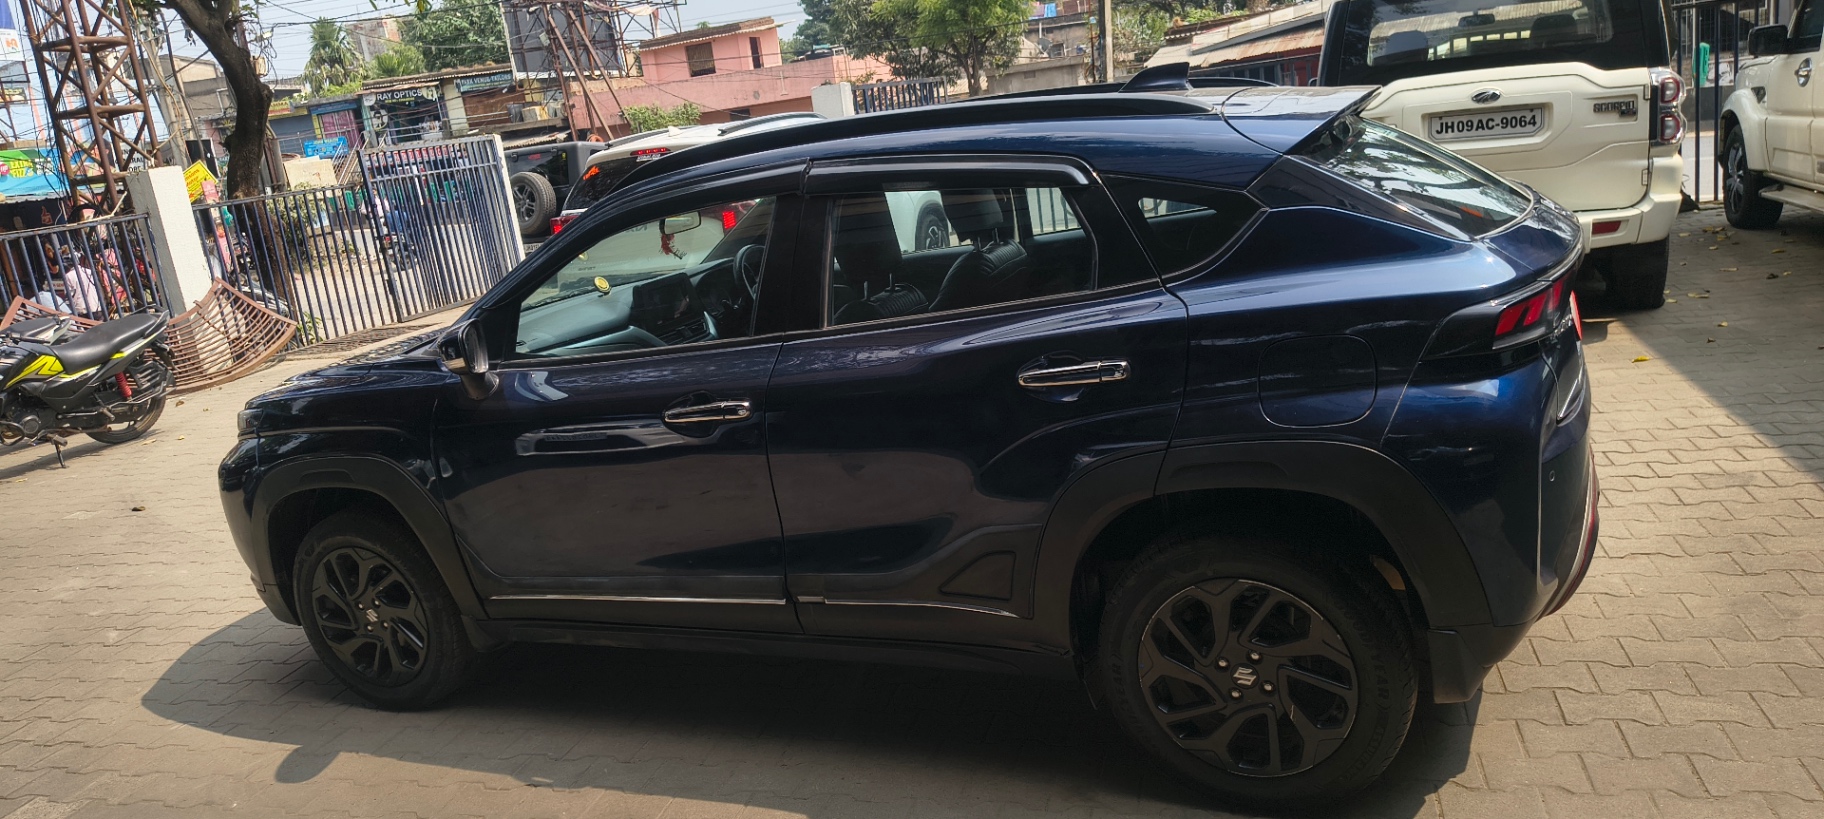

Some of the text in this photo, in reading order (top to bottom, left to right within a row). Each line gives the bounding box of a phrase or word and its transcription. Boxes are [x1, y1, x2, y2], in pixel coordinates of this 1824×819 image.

[377, 92, 392, 101] RAY
[393, 88, 423, 99] OPTICS
[1593, 100, 1635, 112] SCORPIO
[1435, 114, 1538, 135] JH09AC-9064
